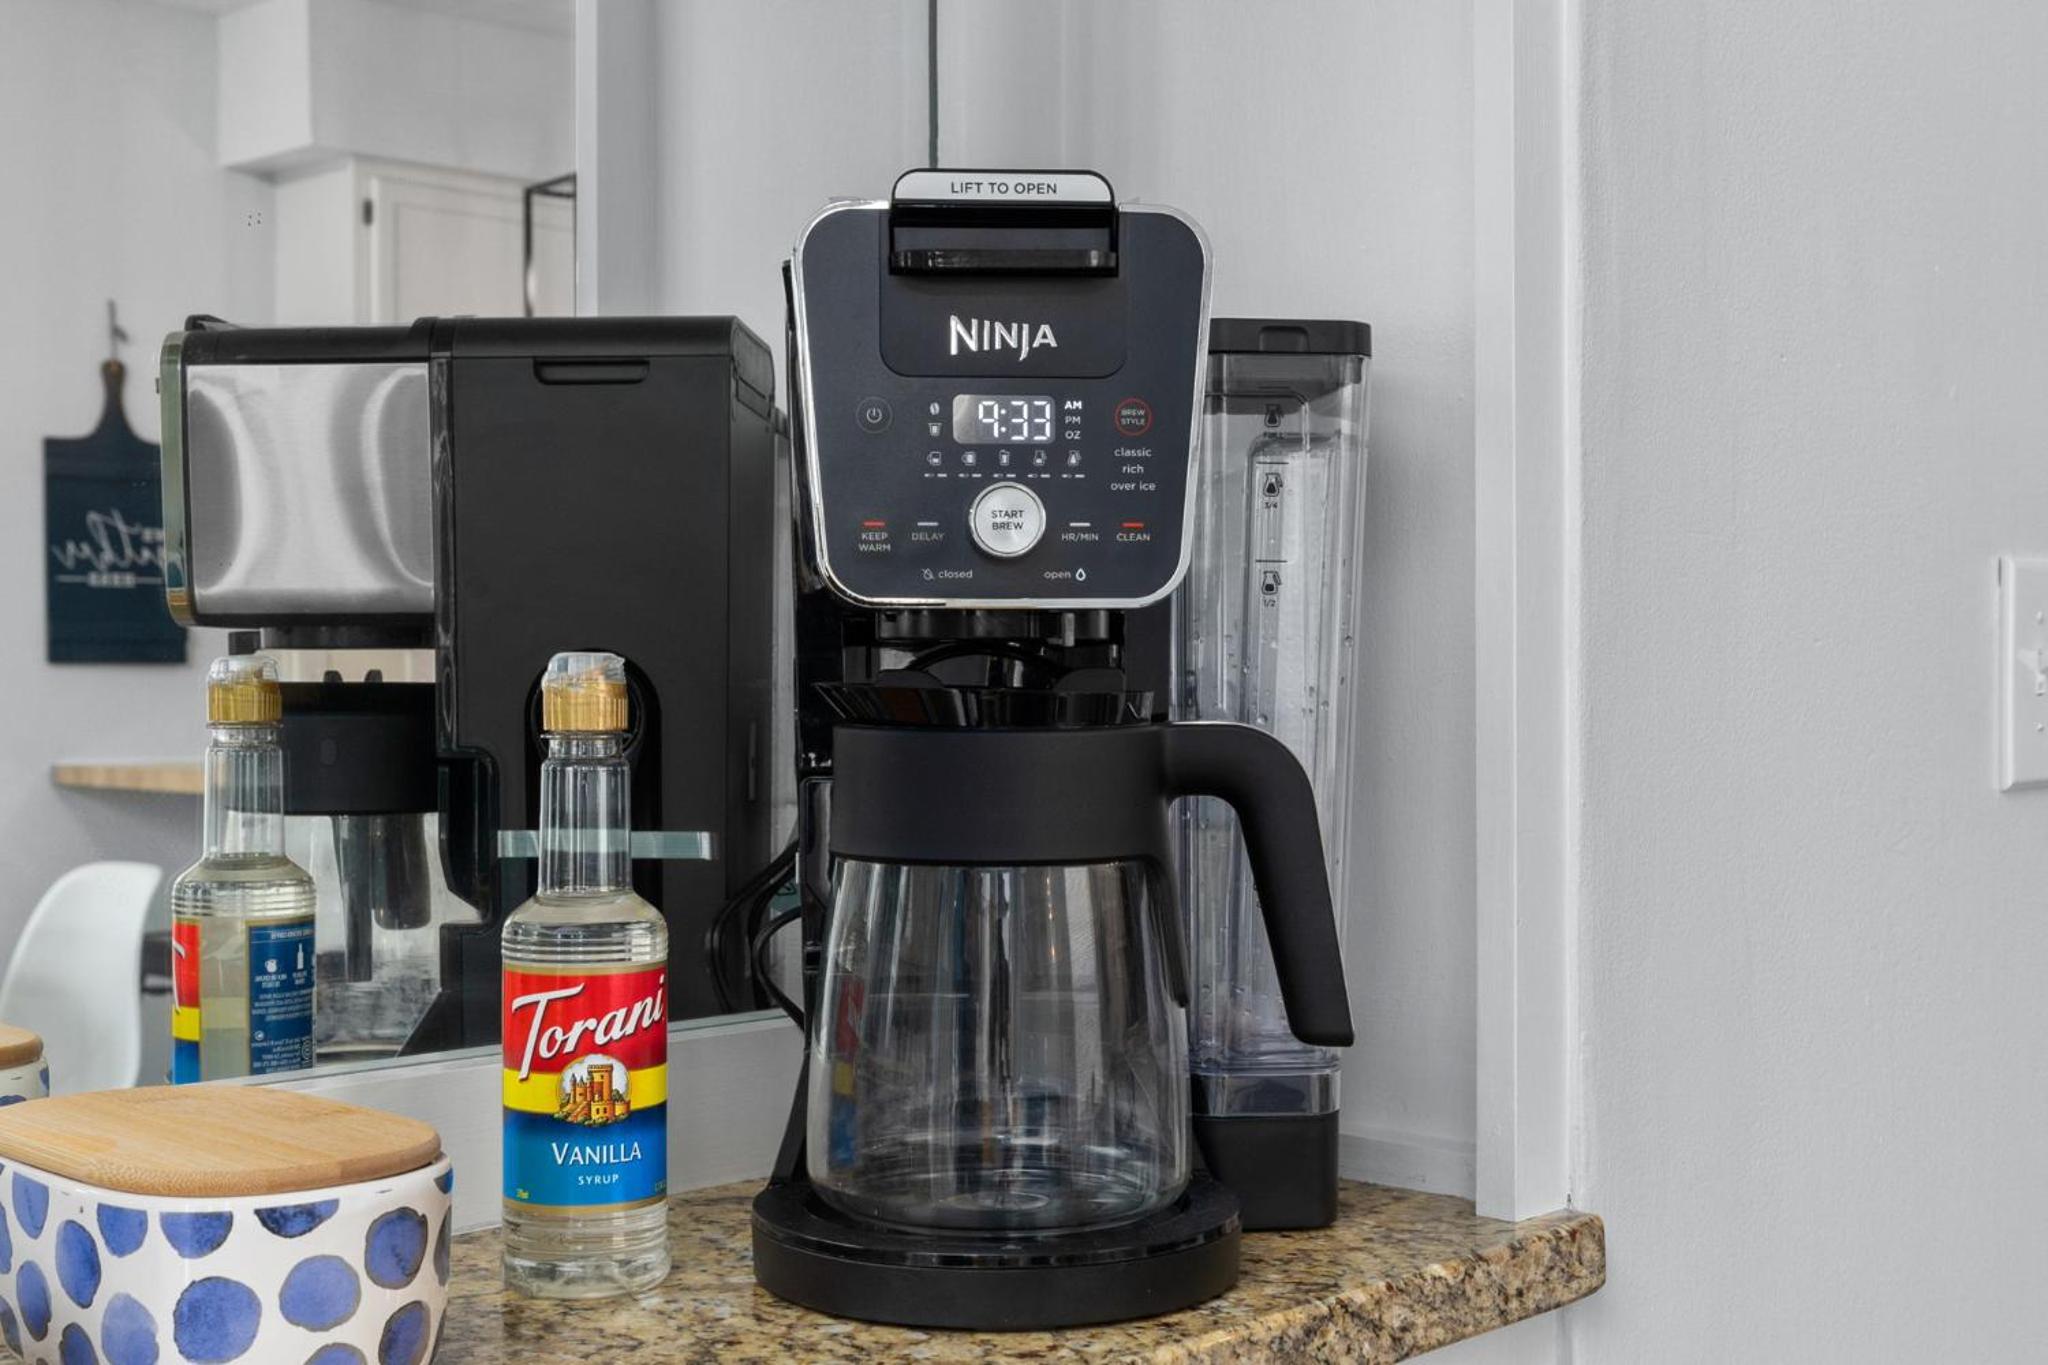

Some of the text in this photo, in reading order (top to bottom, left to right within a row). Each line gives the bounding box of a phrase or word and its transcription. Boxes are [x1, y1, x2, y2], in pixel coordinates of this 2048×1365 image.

[951, 182, 1057, 195] LIFT TO OPEN
[949, 314, 1058, 362] NINJA
[1064, 400, 1083, 410] AM
[1121, 408, 1146, 417] BREW
[978, 400, 1052, 441] 9:33
[1064, 415, 1081, 425] PM
[1120, 418, 1146, 426] STYLE
[1064, 430, 1081, 440] OZ
[1113, 446, 1153, 458] classic
[1121, 463, 1145, 475] rich
[1110, 480, 1157, 492] over ice
[991, 509, 1026, 520] START
[991, 521, 1024, 531] BREW
[861, 531, 889, 541] KEEP
[911, 532, 945, 542] DELAY
[1061, 532, 1099, 543] HR/MIN
[1116, 532, 1151, 543] CLEAN
[858, 542, 892, 553] WARM
[937, 567, 974, 580] closed
[1043, 569, 1072, 580] open
[1263, 599, 1277, 608] 1/2
[510, 973, 667, 1082] Torani
[551, 1141, 643, 1166] VANILLA
[577, 1173, 620, 1186] SYRUP
